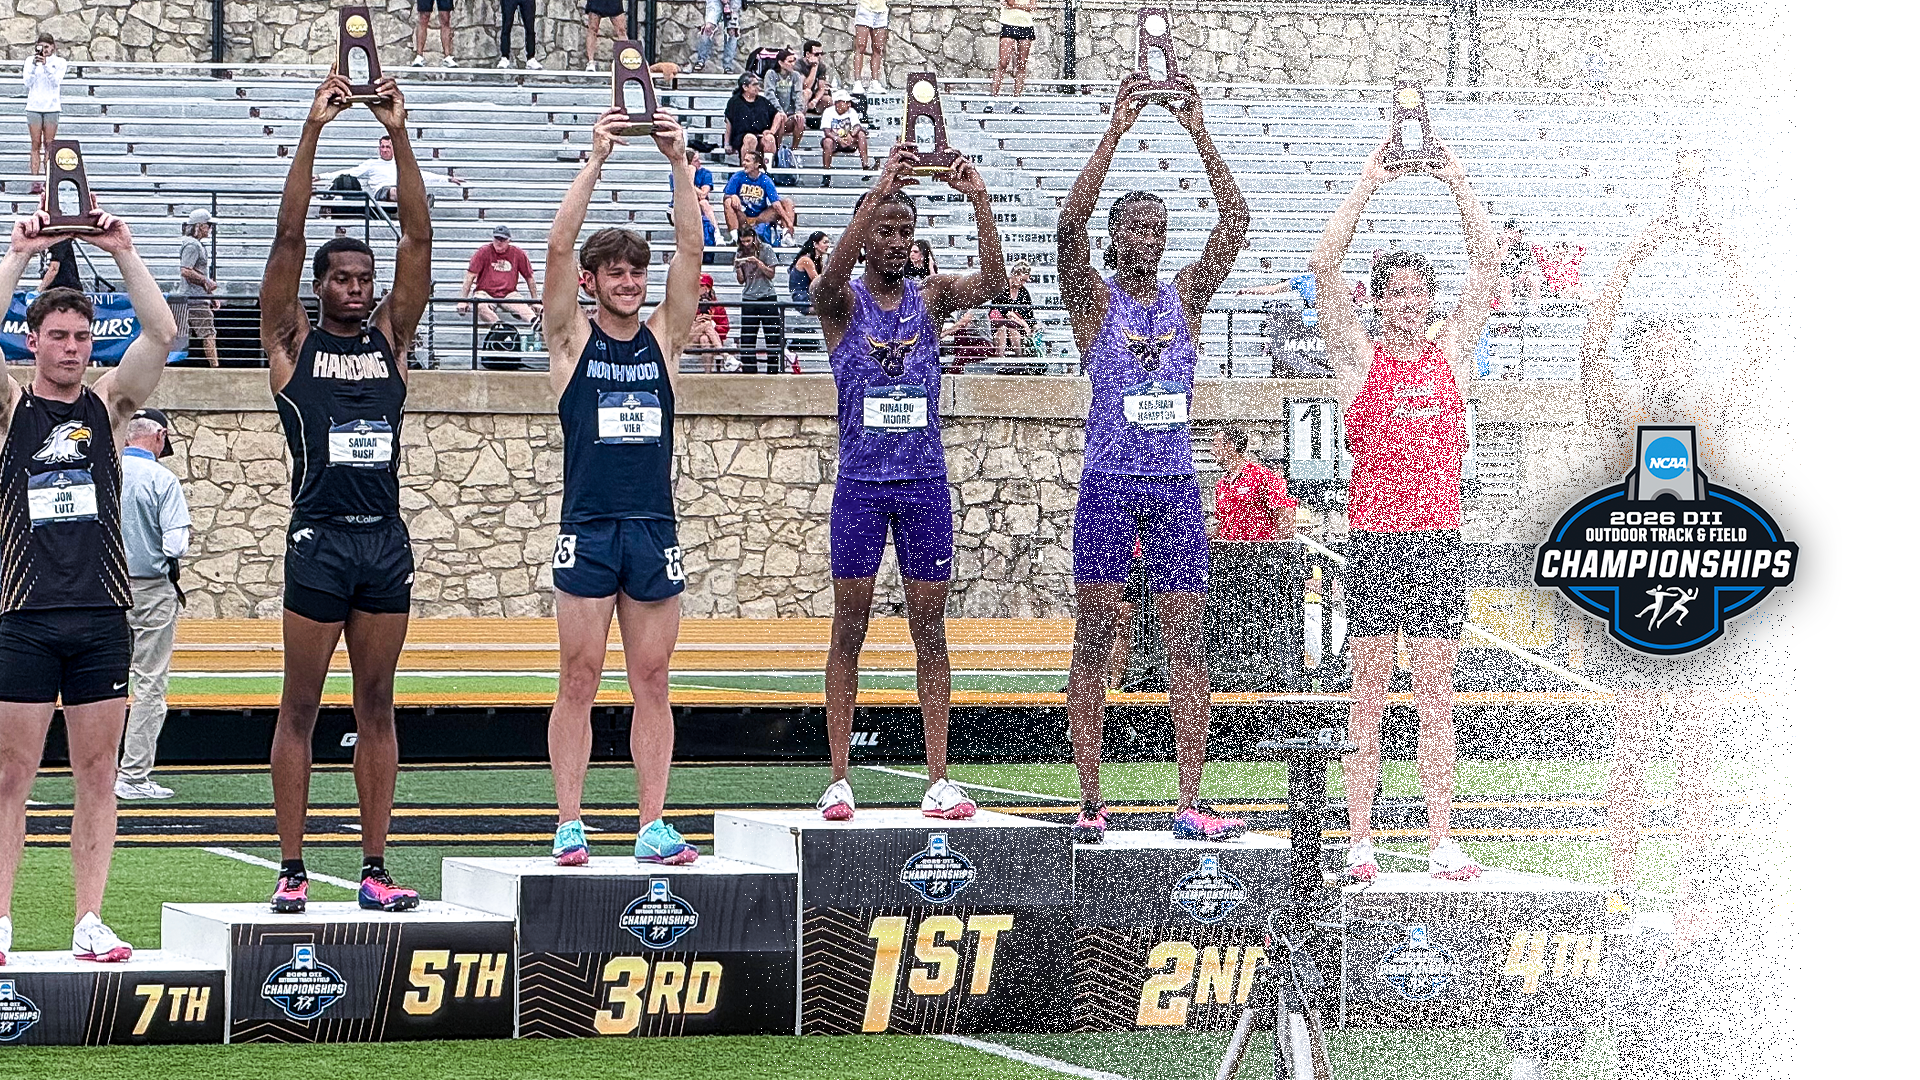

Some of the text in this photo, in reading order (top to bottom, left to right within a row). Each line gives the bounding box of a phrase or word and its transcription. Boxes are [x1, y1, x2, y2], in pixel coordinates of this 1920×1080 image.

[3, 320, 30, 334] MA
[880, 403, 914, 413] RINALDO
[620, 412, 644, 422] BLAKE
[883, 415, 911, 424] MOORE
[623, 424, 641, 433] VIER
[348, 438, 377, 447] SAVIAN
[352, 450, 374, 459] BUSH
[55, 491, 72, 502] JON
[55, 503, 74, 514] LUTZ
[850, 731, 879, 746] ILL
[903, 869, 974, 880] CHAMPIONSHIPS
[622, 915, 696, 926] CHAMPIONSHIPS
[1503, 930, 1600, 994] 4TH
[862, 914, 1015, 1033] 1ST
[402, 950, 508, 1014] 5TH
[264, 983, 344, 995] CHAMPIONSHIPS
[593, 956, 723, 1034] 3RD
[132, 984, 211, 1035] 7TH
[0, 1011, 38, 1020] IONSHIPS
